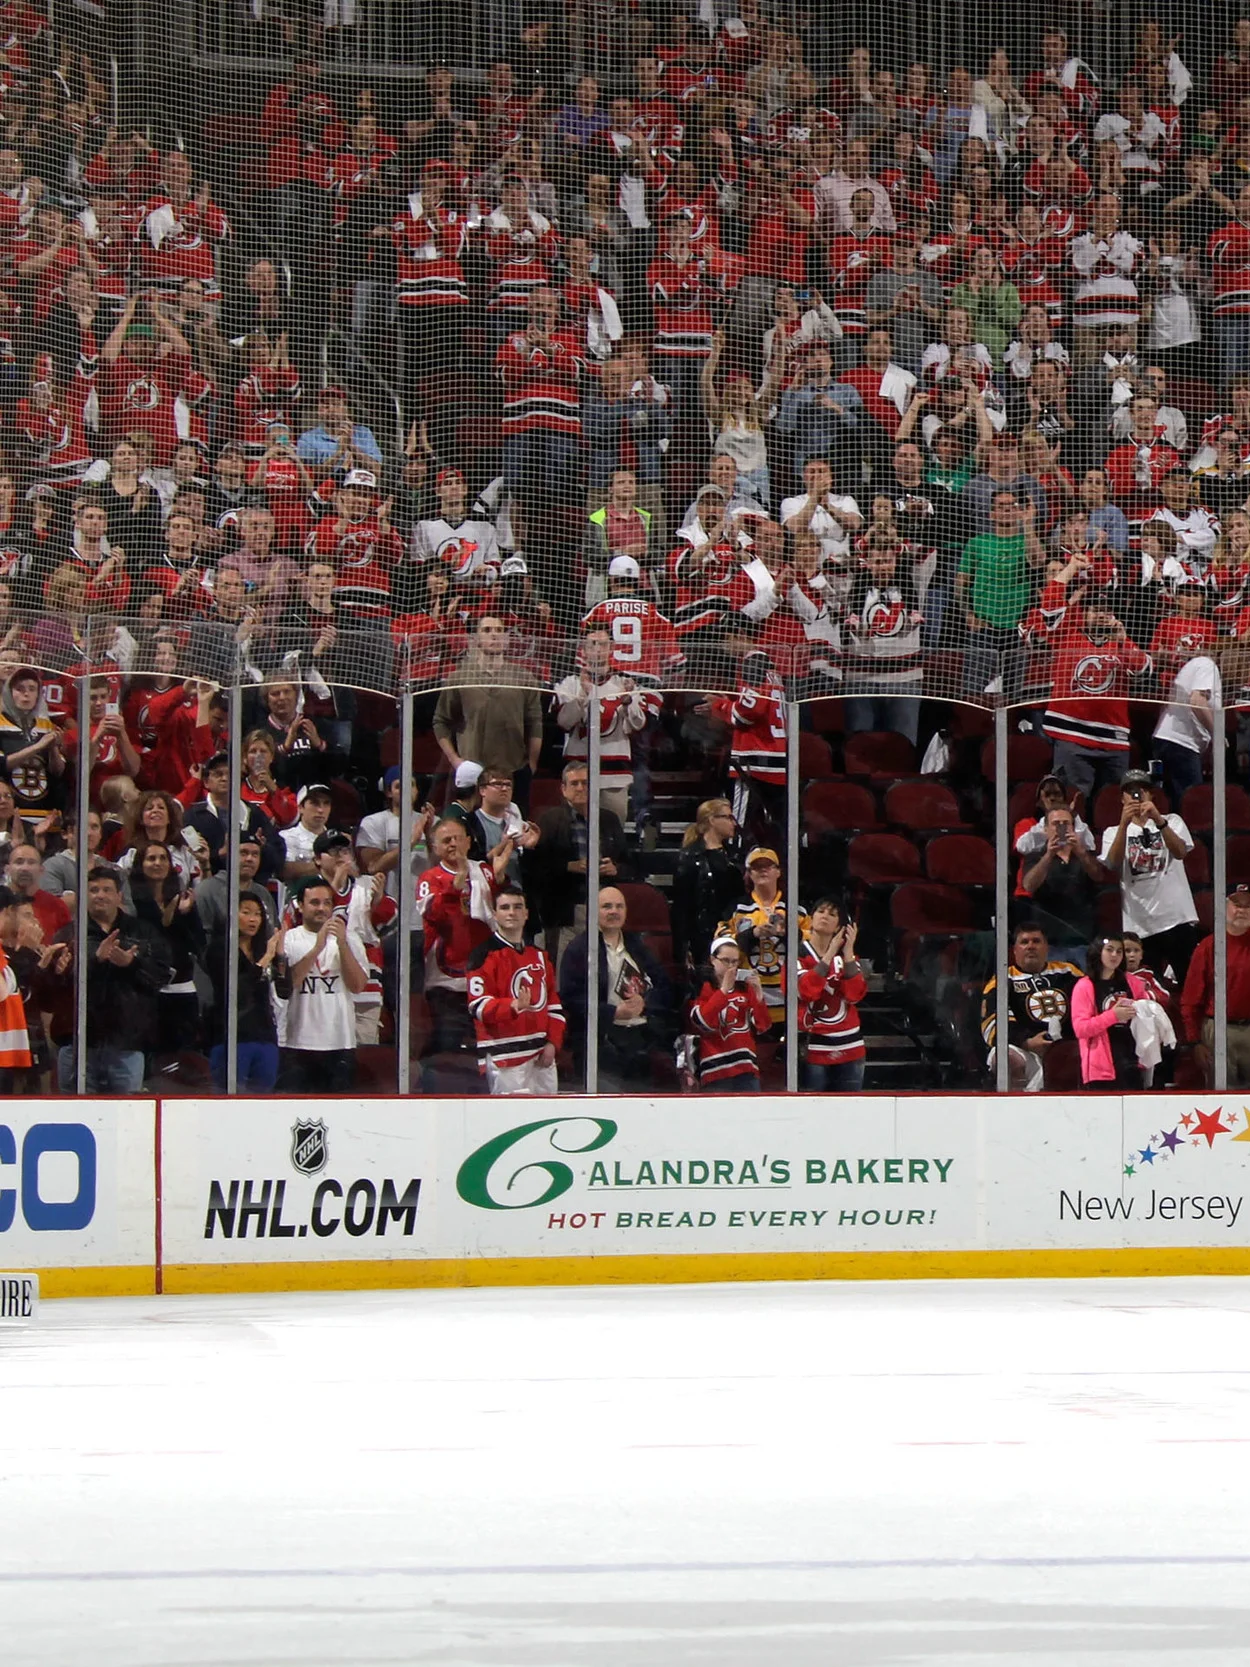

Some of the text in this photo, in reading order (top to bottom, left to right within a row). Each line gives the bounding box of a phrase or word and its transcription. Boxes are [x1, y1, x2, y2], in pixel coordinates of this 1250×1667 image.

[605, 602, 649, 615] PARISE
[612, 616, 642, 662] 9
[300, 975, 340, 995] NY
[469, 976, 485, 997] 6
[0, 1122, 97, 1232] O
[805, 1158, 955, 1184] BAKERY
[204, 1178, 422, 1239] NHL.COM
[548, 1209, 937, 1229] HOT BREAD EVERY HOUR!
[1059, 1189, 1135, 1220] New
[1145, 1189, 1243, 1227] Jersey
